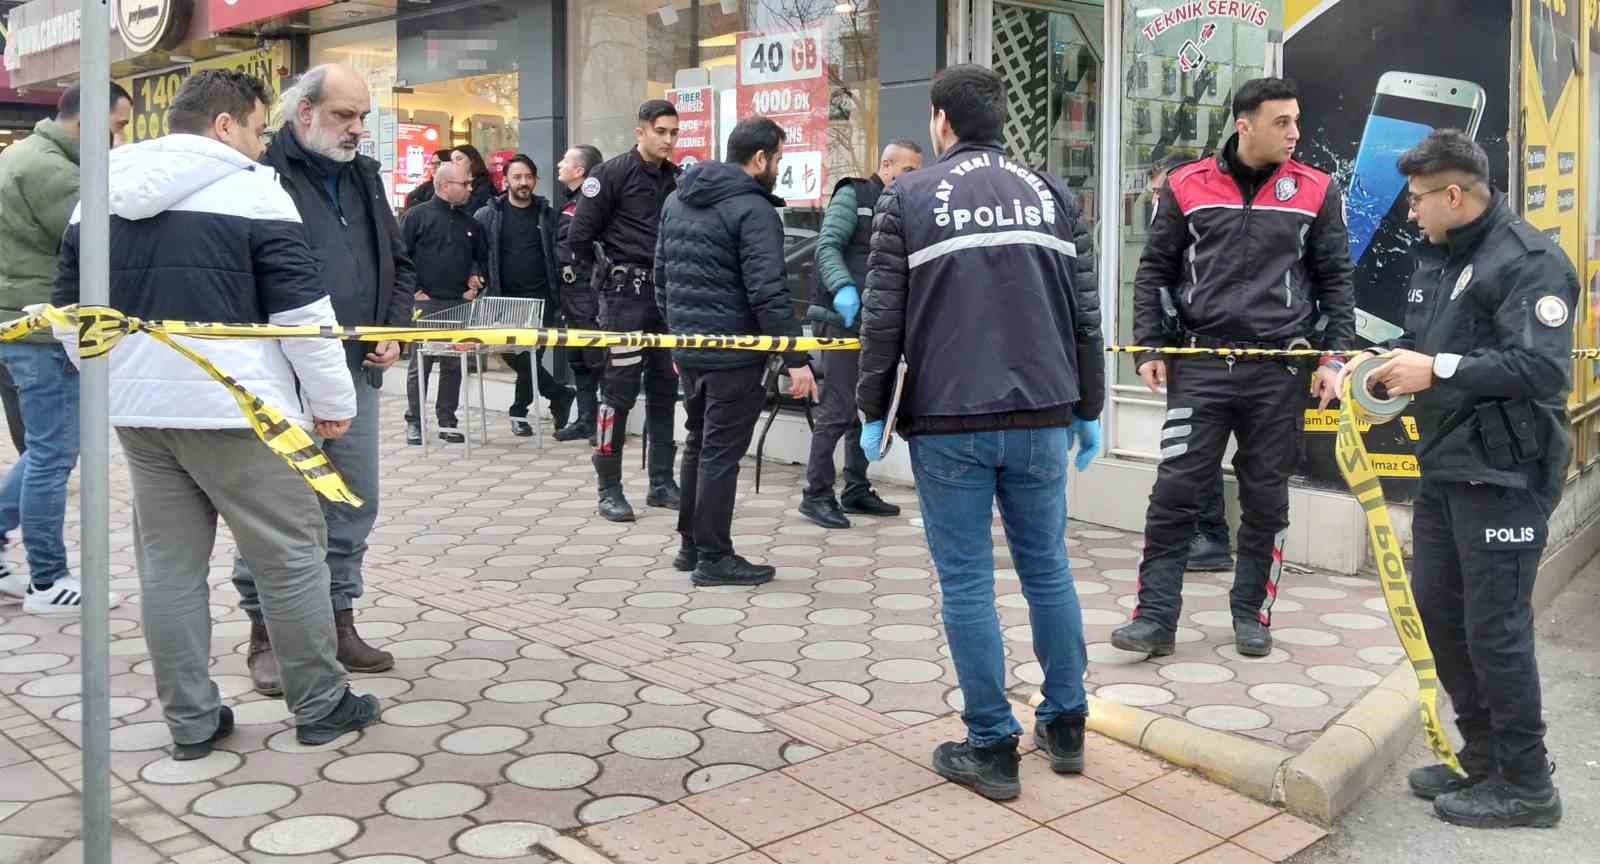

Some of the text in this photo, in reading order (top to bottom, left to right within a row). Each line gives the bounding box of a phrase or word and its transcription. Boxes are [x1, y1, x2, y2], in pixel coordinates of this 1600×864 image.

[1143, 0, 1269, 40] TEKNİK SERVİS
[750, 37, 817, 74] 40 GB
[752, 89, 810, 113] 1000 DK
[933, 178, 954, 227] OLAY
[950, 152, 991, 176] YERİ
[952, 199, 1042, 231] POLİS
[1305, 417, 1322, 425] am
[1371, 457, 1398, 471] lmaz
[1485, 526, 1535, 543] POLİS
